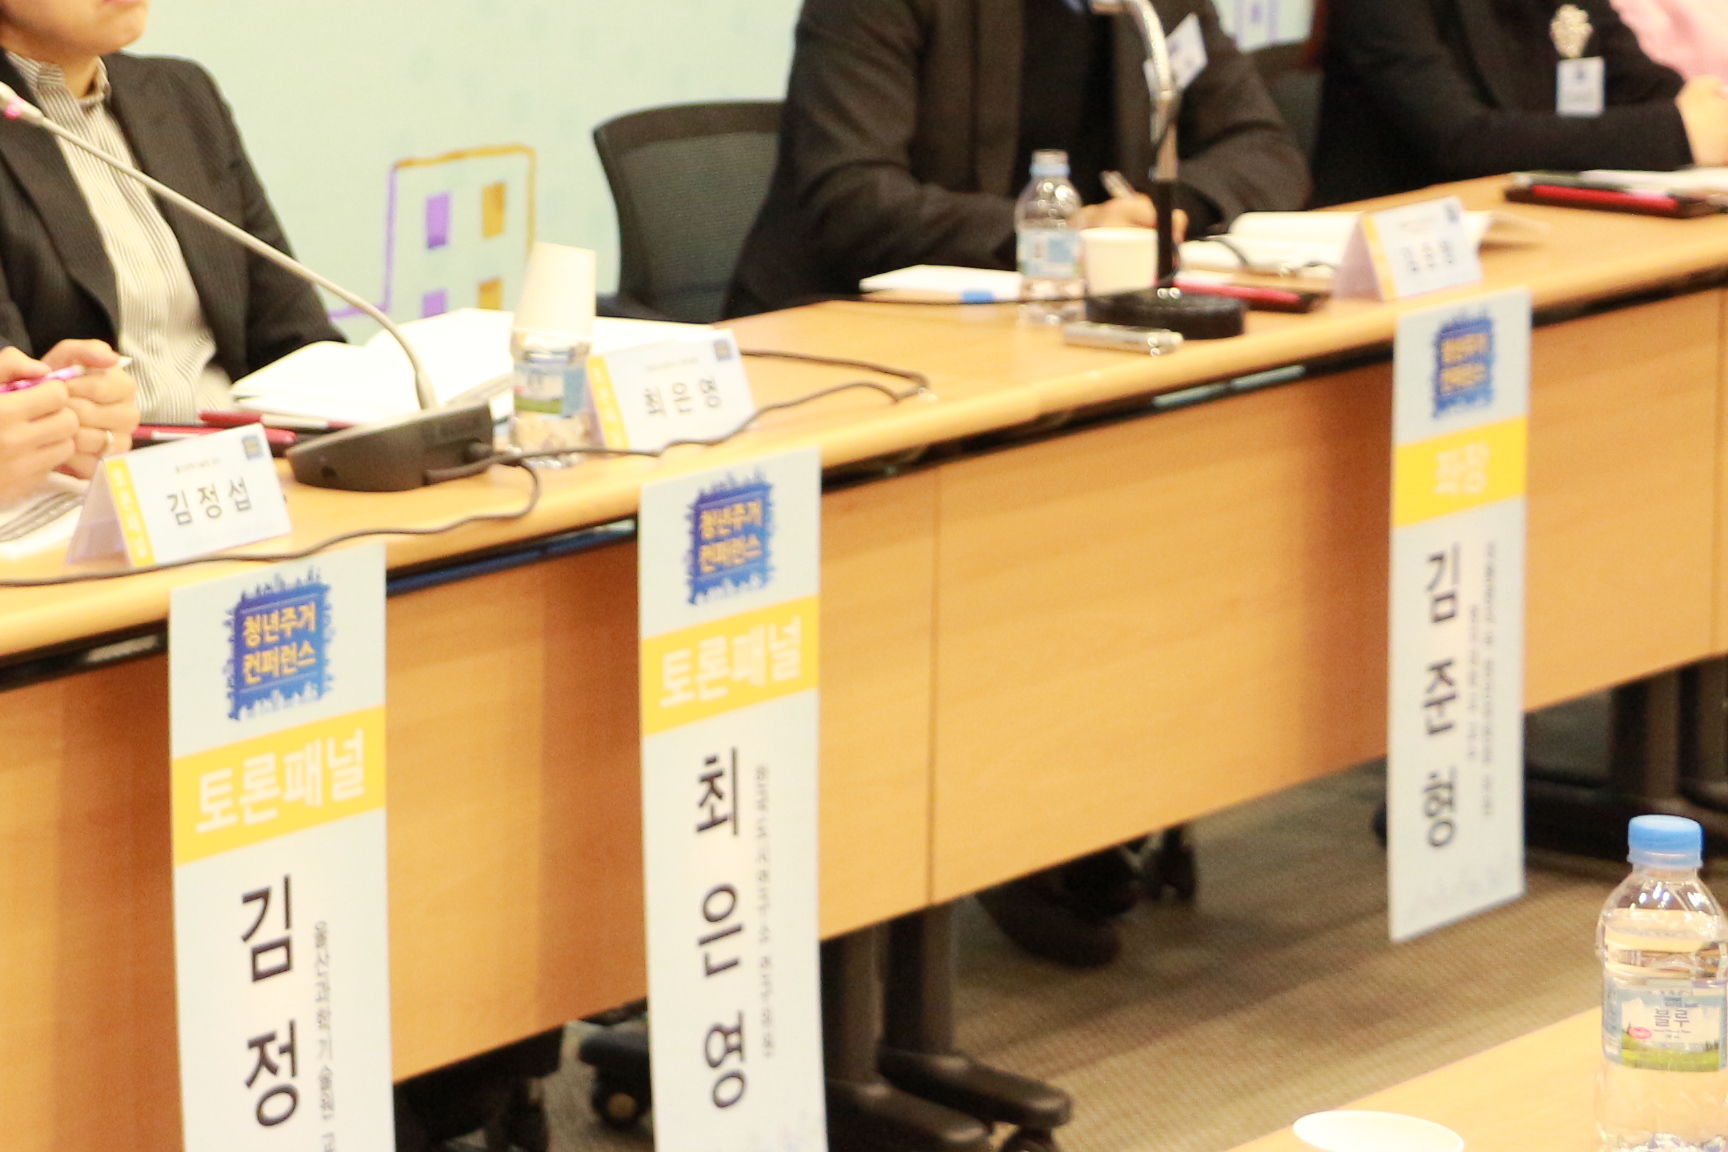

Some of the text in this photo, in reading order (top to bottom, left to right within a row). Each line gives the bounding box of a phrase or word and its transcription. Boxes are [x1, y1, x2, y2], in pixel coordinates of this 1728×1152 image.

[166, 475, 252, 527] 김정섭
[242, 601, 317, 648] 청년주거
[242, 639, 317, 686] 컨퍼런스
[659, 614, 802, 708] 토론패널
[195, 727, 365, 834] 토론패널
